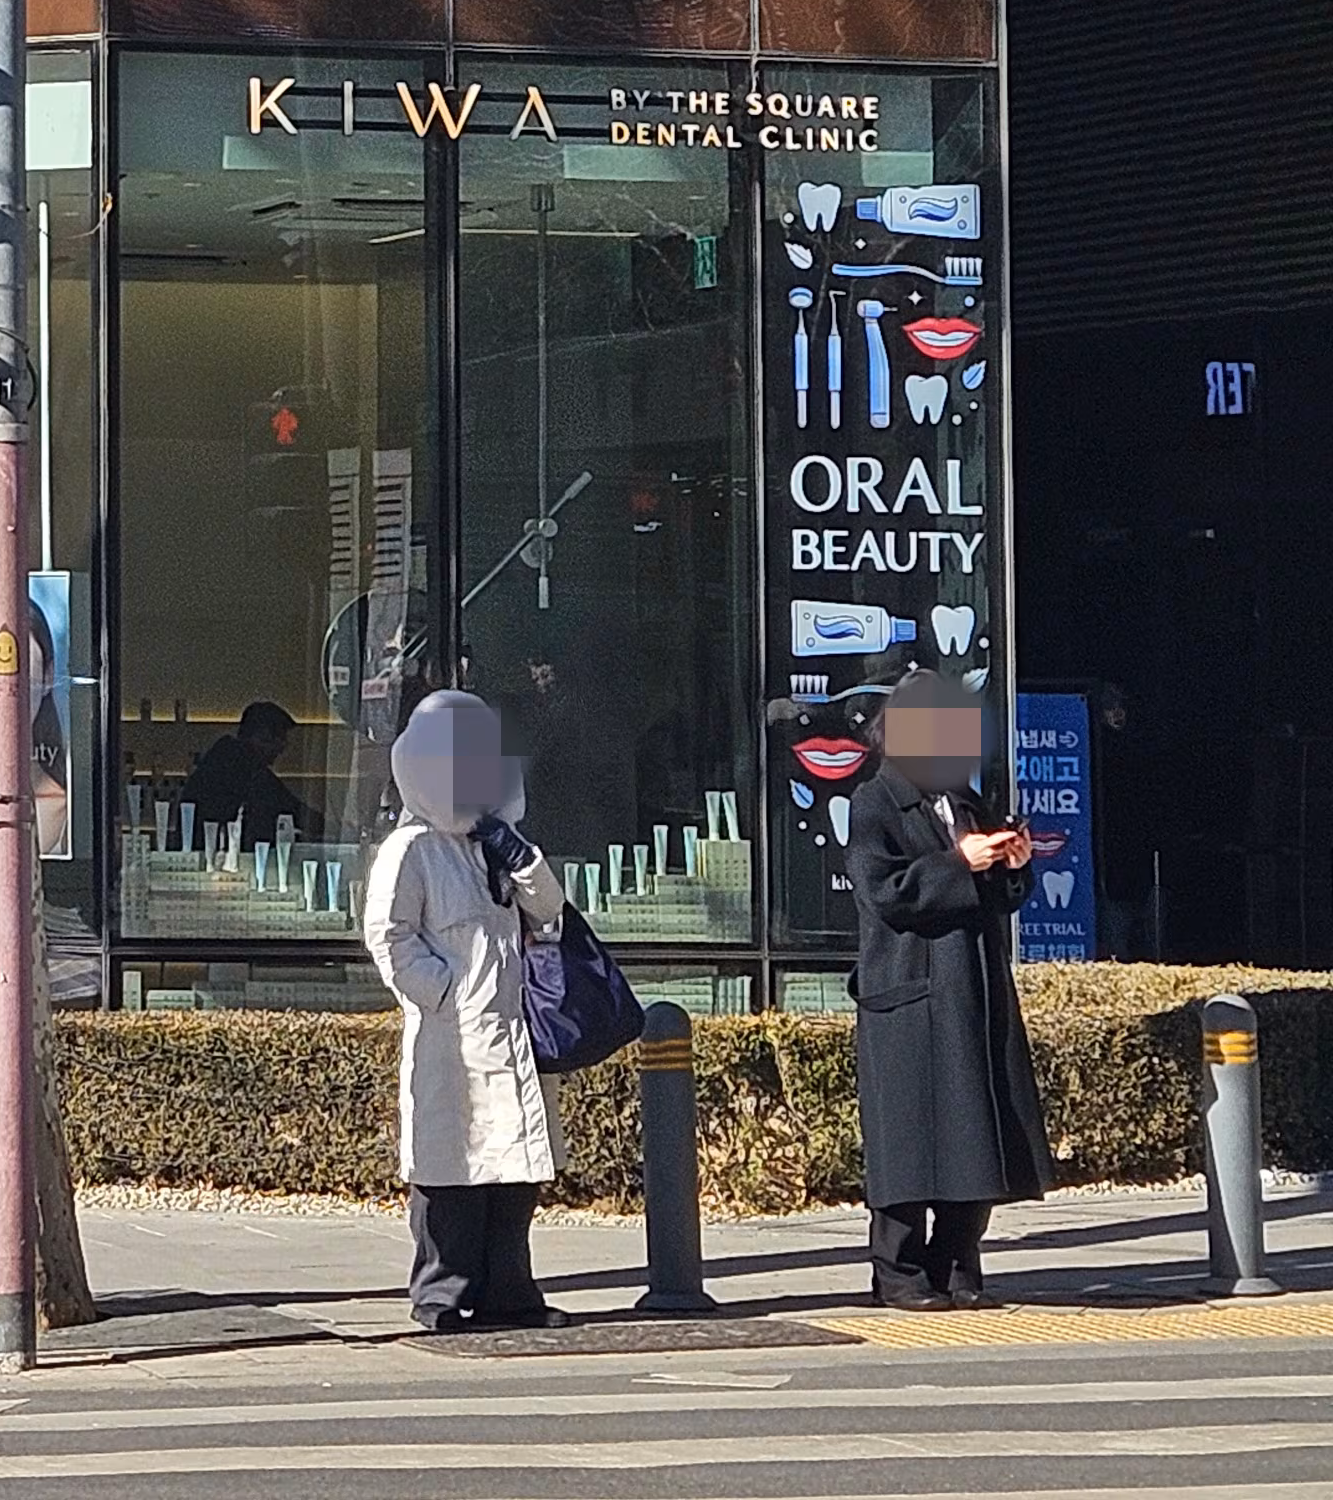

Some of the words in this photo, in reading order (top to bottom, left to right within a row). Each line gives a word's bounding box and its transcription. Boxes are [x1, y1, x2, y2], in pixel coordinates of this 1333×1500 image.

[248, 77, 558, 142] KIWA
[610, 88, 650, 111] BY
[666, 90, 731, 115] THE
[745, 92, 880, 120] SQUARE
[610, 121, 743, 149] DENTAL
[758, 125, 879, 152] CLINIC
[790, 455, 984, 515] ORAL
[791, 528, 984, 573] BEAUTY
[1042, 922, 1086, 937] TRIAL
